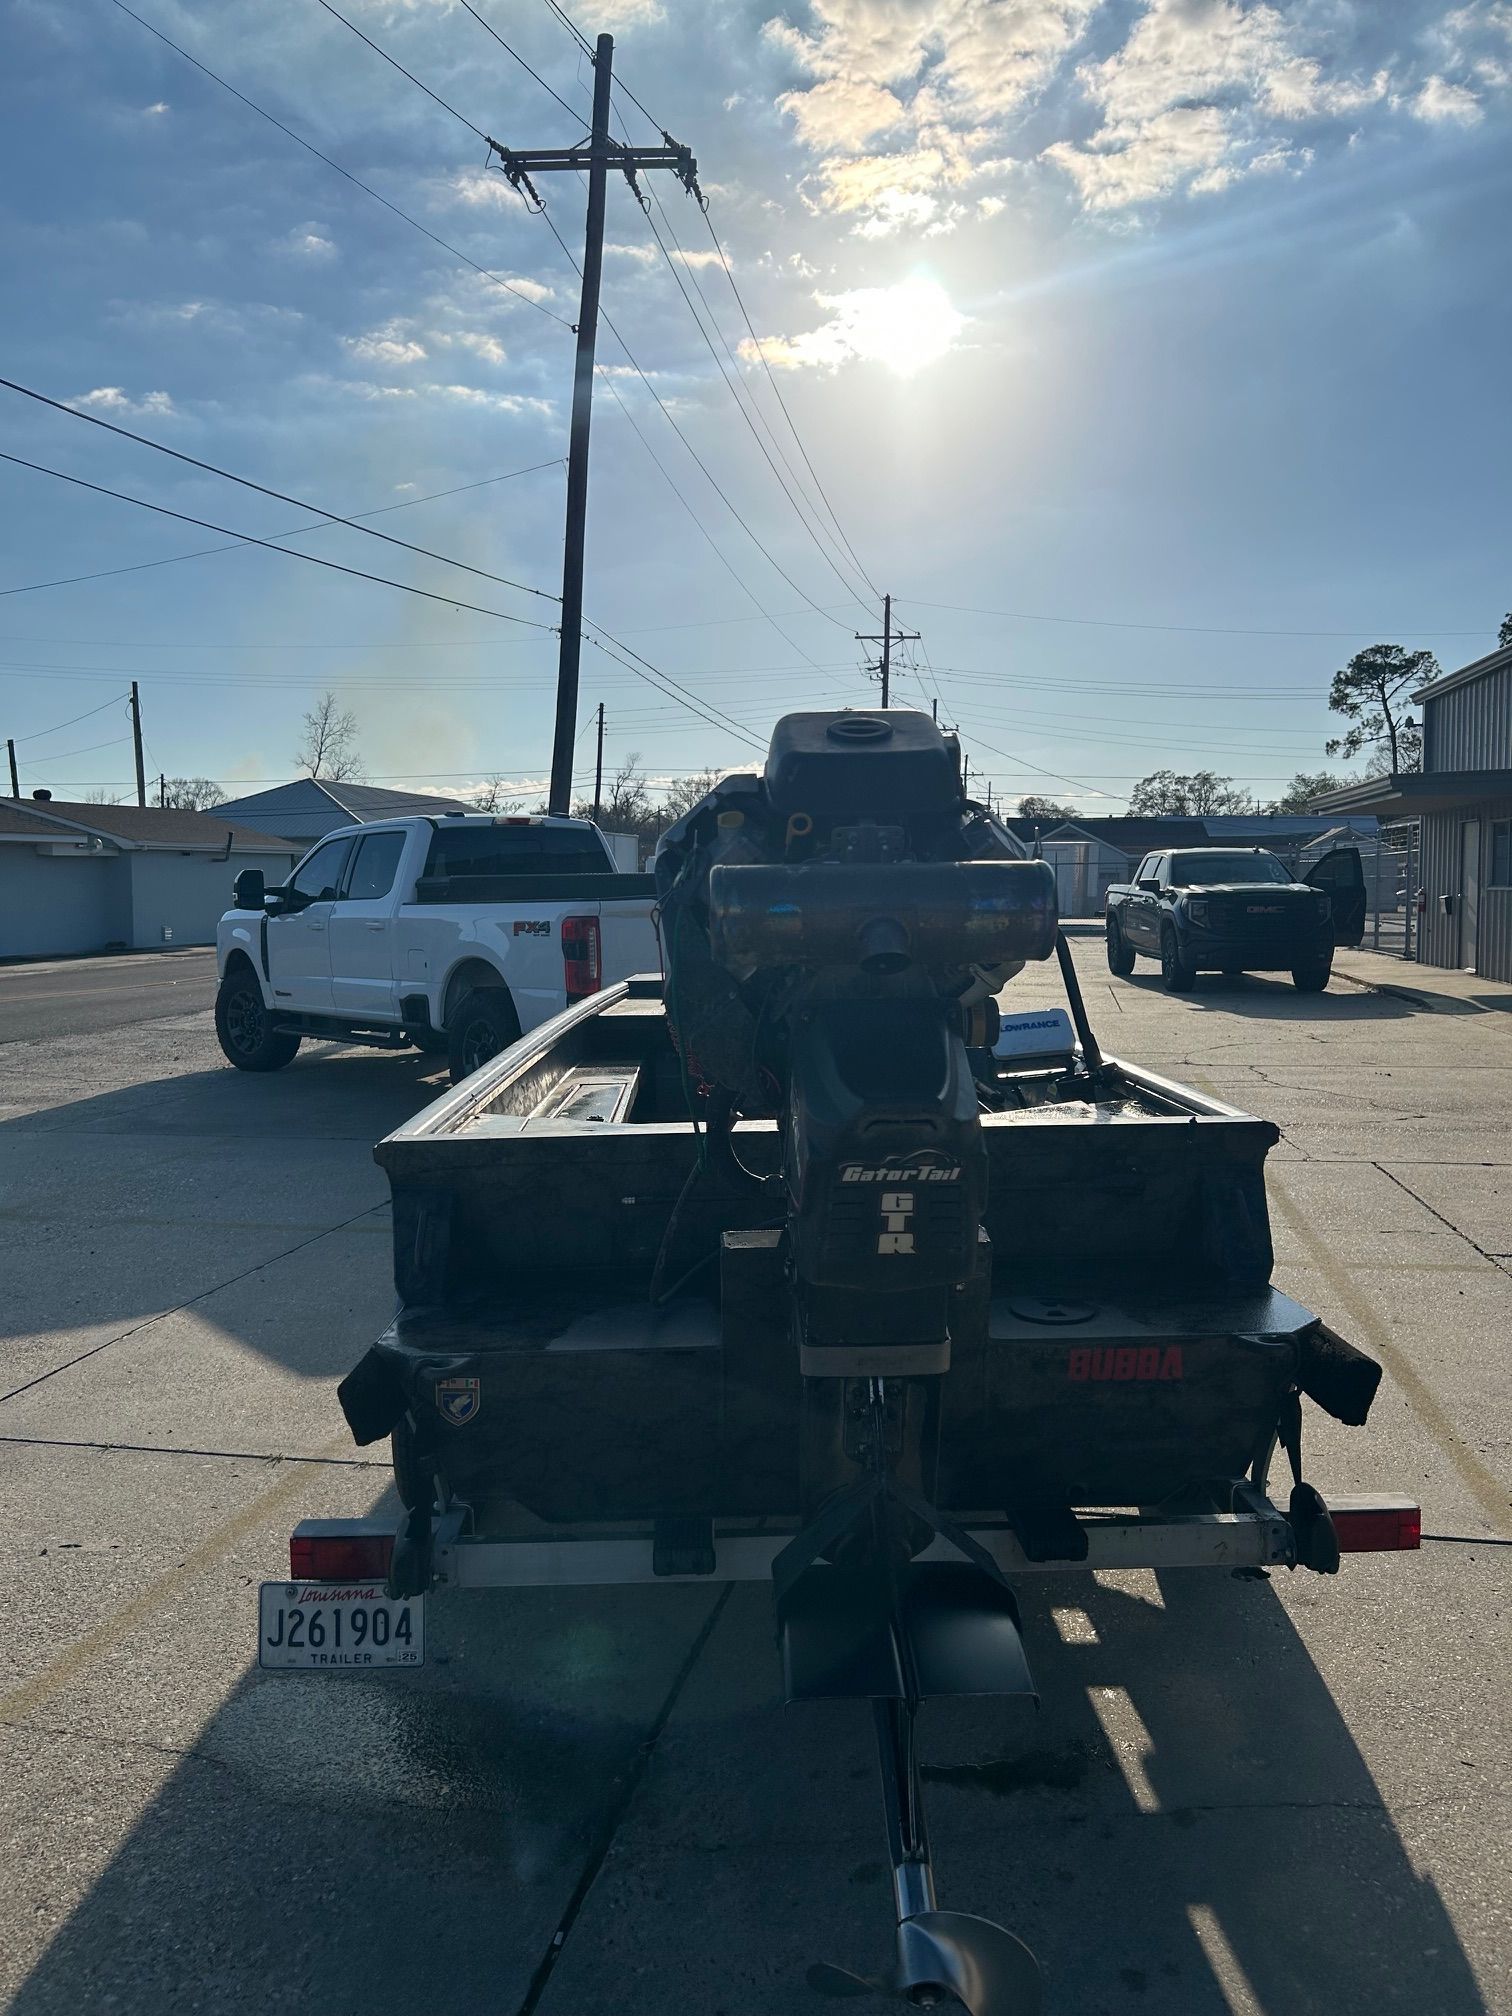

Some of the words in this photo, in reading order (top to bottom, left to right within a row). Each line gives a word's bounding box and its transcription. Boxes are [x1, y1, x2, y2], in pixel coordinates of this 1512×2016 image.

[1247, 905, 1285, 913] GMC
[513, 920, 550, 936] FX4
[1000, 1019, 1060, 1032] LOWRANCE
[842, 1165, 961, 1182] GatorTail
[1068, 1344, 1184, 1381] BUBBA
[298, 1586, 383, 1604] Louisiana
[266, 1607, 412, 1648] J261904
[310, 1653, 373, 1664] TRAILER
